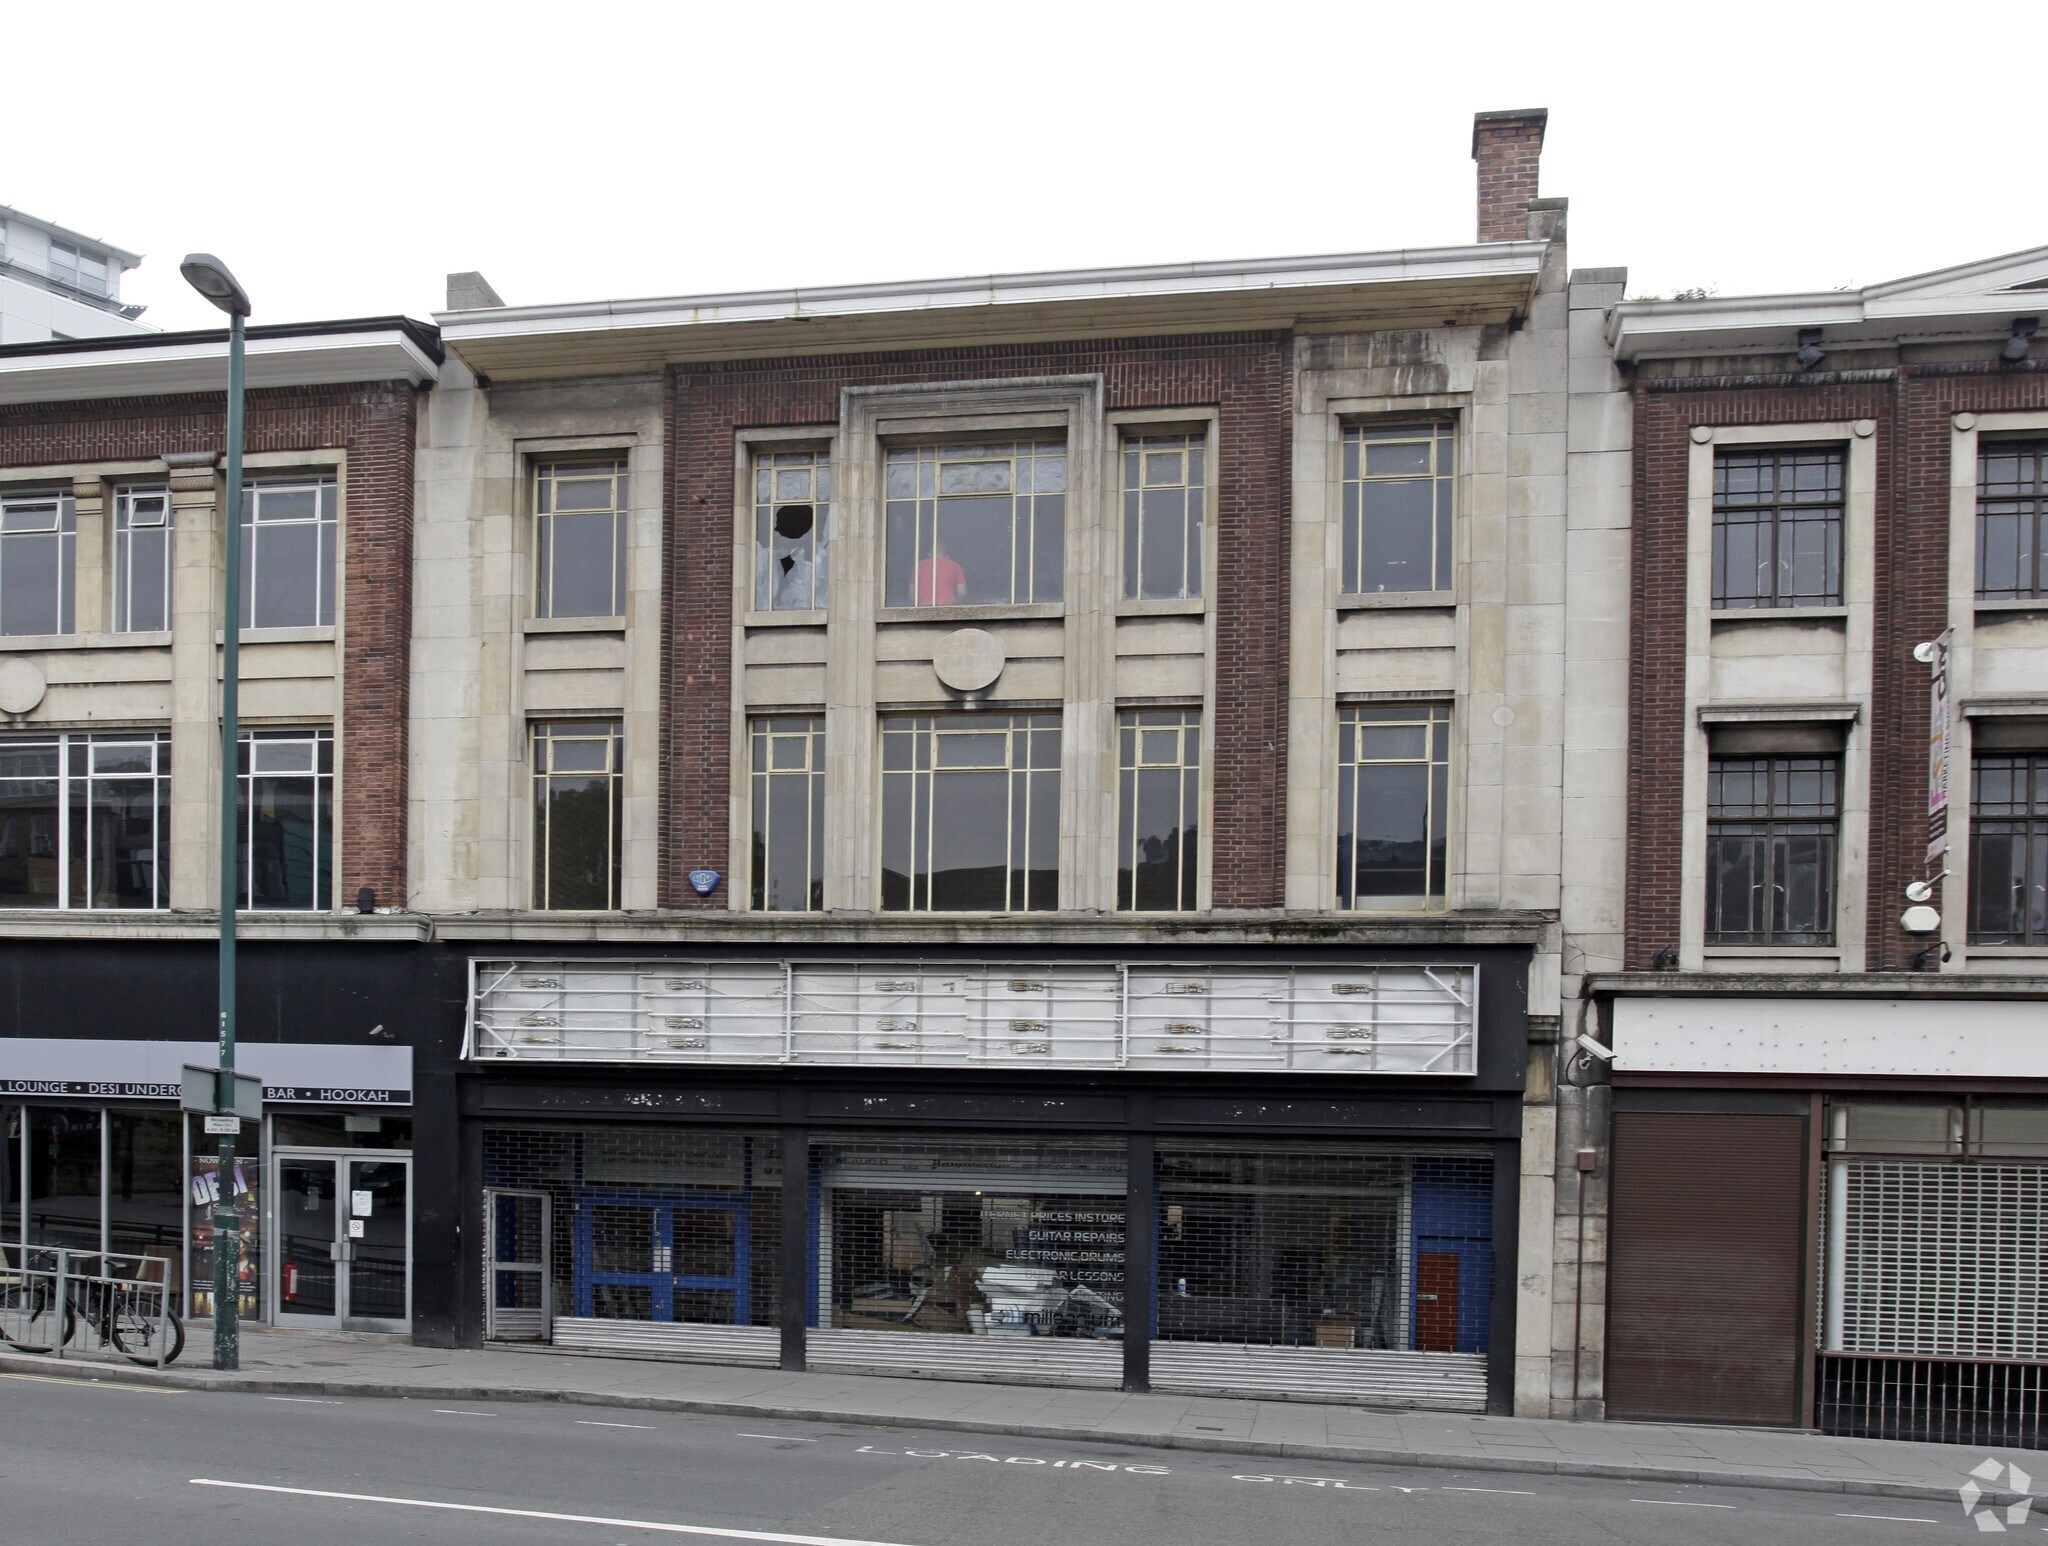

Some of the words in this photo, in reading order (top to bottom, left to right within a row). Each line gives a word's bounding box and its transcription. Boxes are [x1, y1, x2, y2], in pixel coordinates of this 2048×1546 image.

[8, 1081, 68, 1093] LOUNGE
[89, 1083, 120, 1094] DESI
[267, 1088, 296, 1100] BAR
[320, 1089, 389, 1102] HOOKAH
[192, 1163, 249, 1206] DEI
[1030, 1211, 1073, 1222] PRICES
[1075, 1212, 1125, 1224] INSTORE
[1028, 1230, 1072, 1242] GUITAR
[1074, 1231, 1125, 1243] REPAIRS
[1005, 1249, 1078, 1261] ELECTRONIC
[1080, 1251, 1125, 1263] DRUMS
[1069, 1270, 1125, 1282] LESSONS
[854, 1445, 1173, 1475] LOADING
[1231, 1473, 1430, 1493] ONLY
